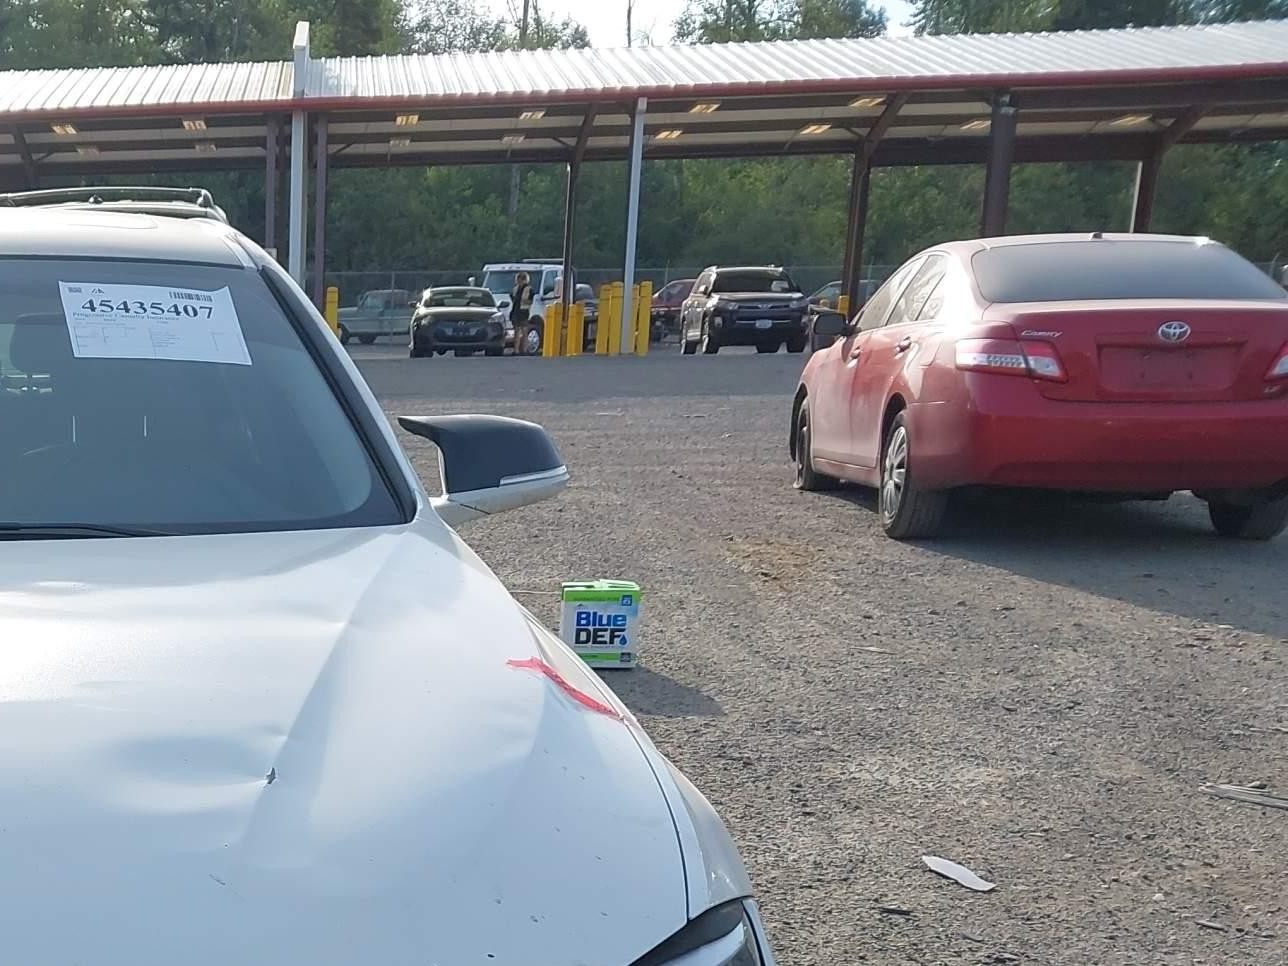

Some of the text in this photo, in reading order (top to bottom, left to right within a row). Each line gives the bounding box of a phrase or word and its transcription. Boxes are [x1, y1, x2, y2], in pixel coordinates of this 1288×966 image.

[82, 299, 213, 319] 45435407
[576, 611, 627, 628] Blue
[574, 628, 626, 645] DEF
